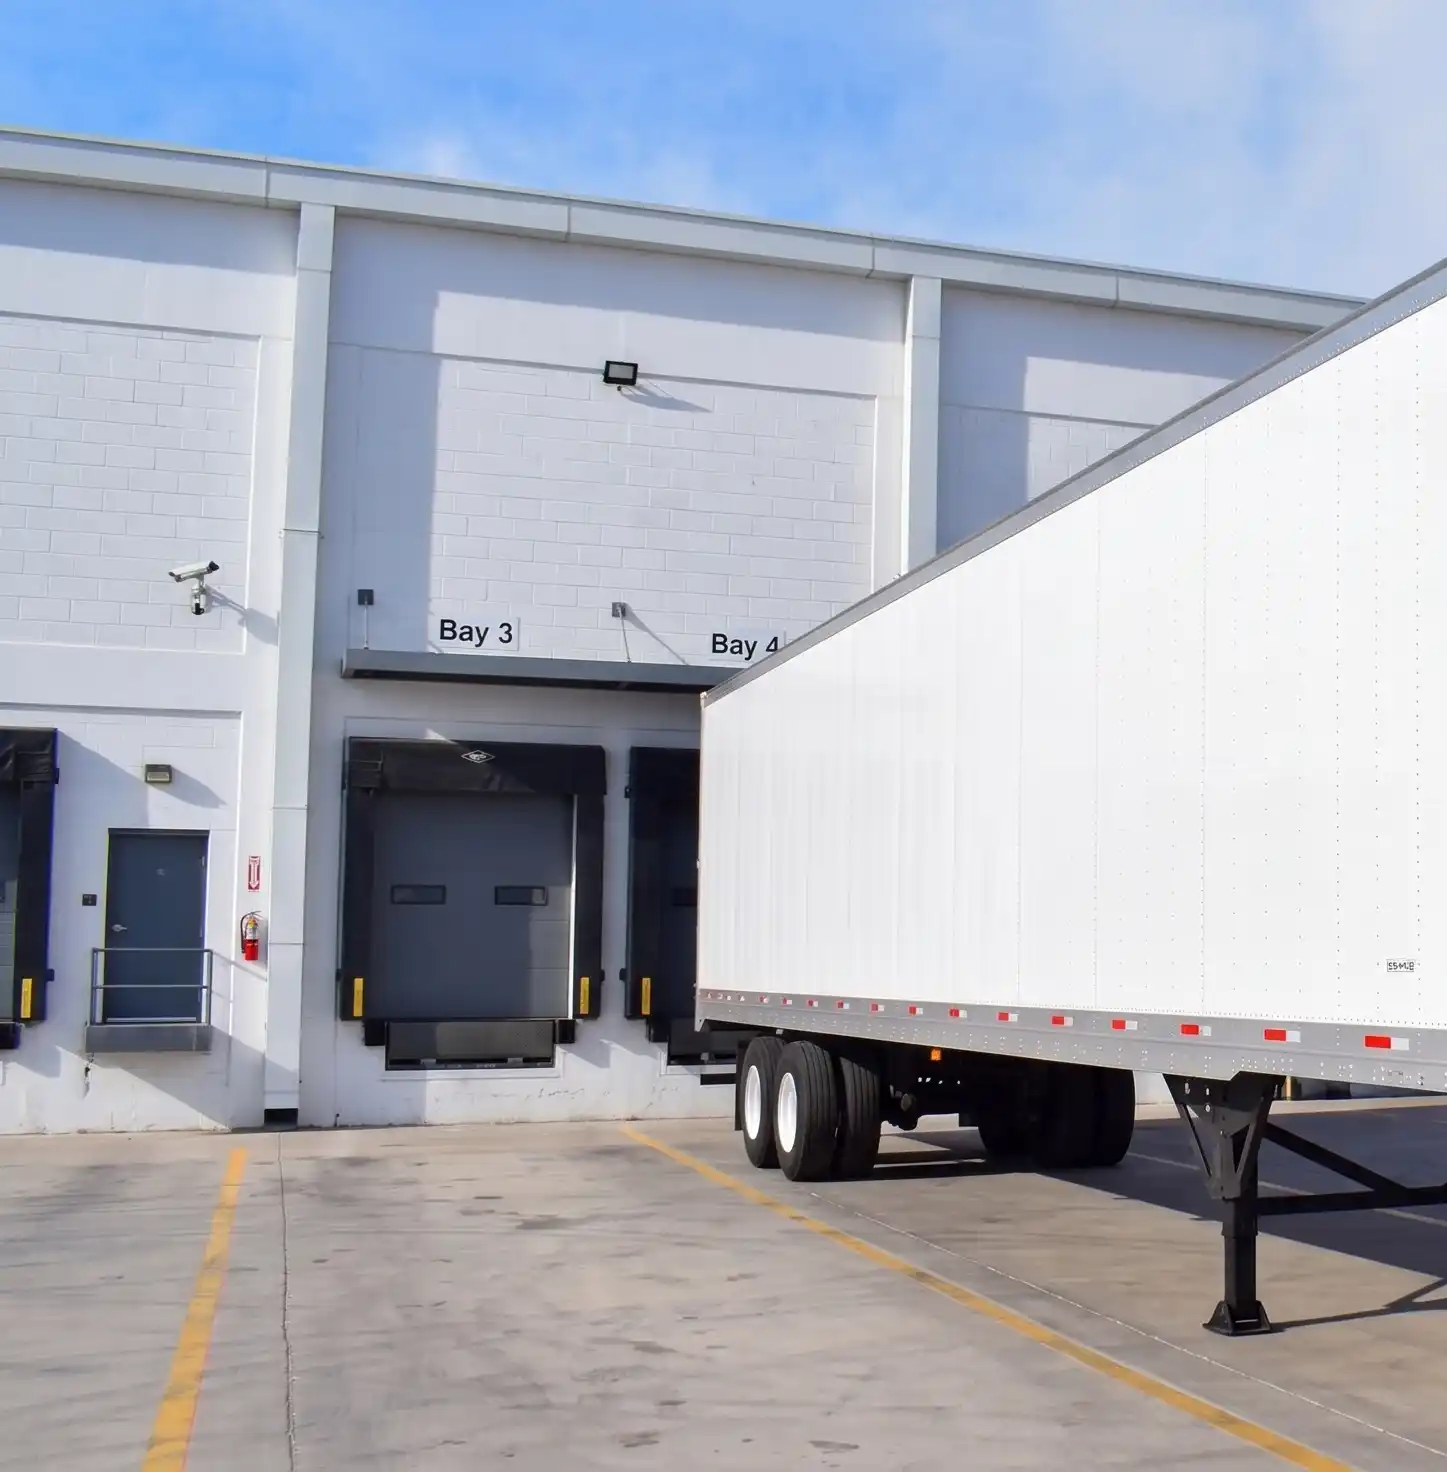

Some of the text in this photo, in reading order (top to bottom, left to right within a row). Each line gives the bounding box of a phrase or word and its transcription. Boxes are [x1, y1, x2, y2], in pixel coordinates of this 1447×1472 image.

[439, 619, 514, 647] Bay 3
[712, 633, 779, 660] Bay 4
